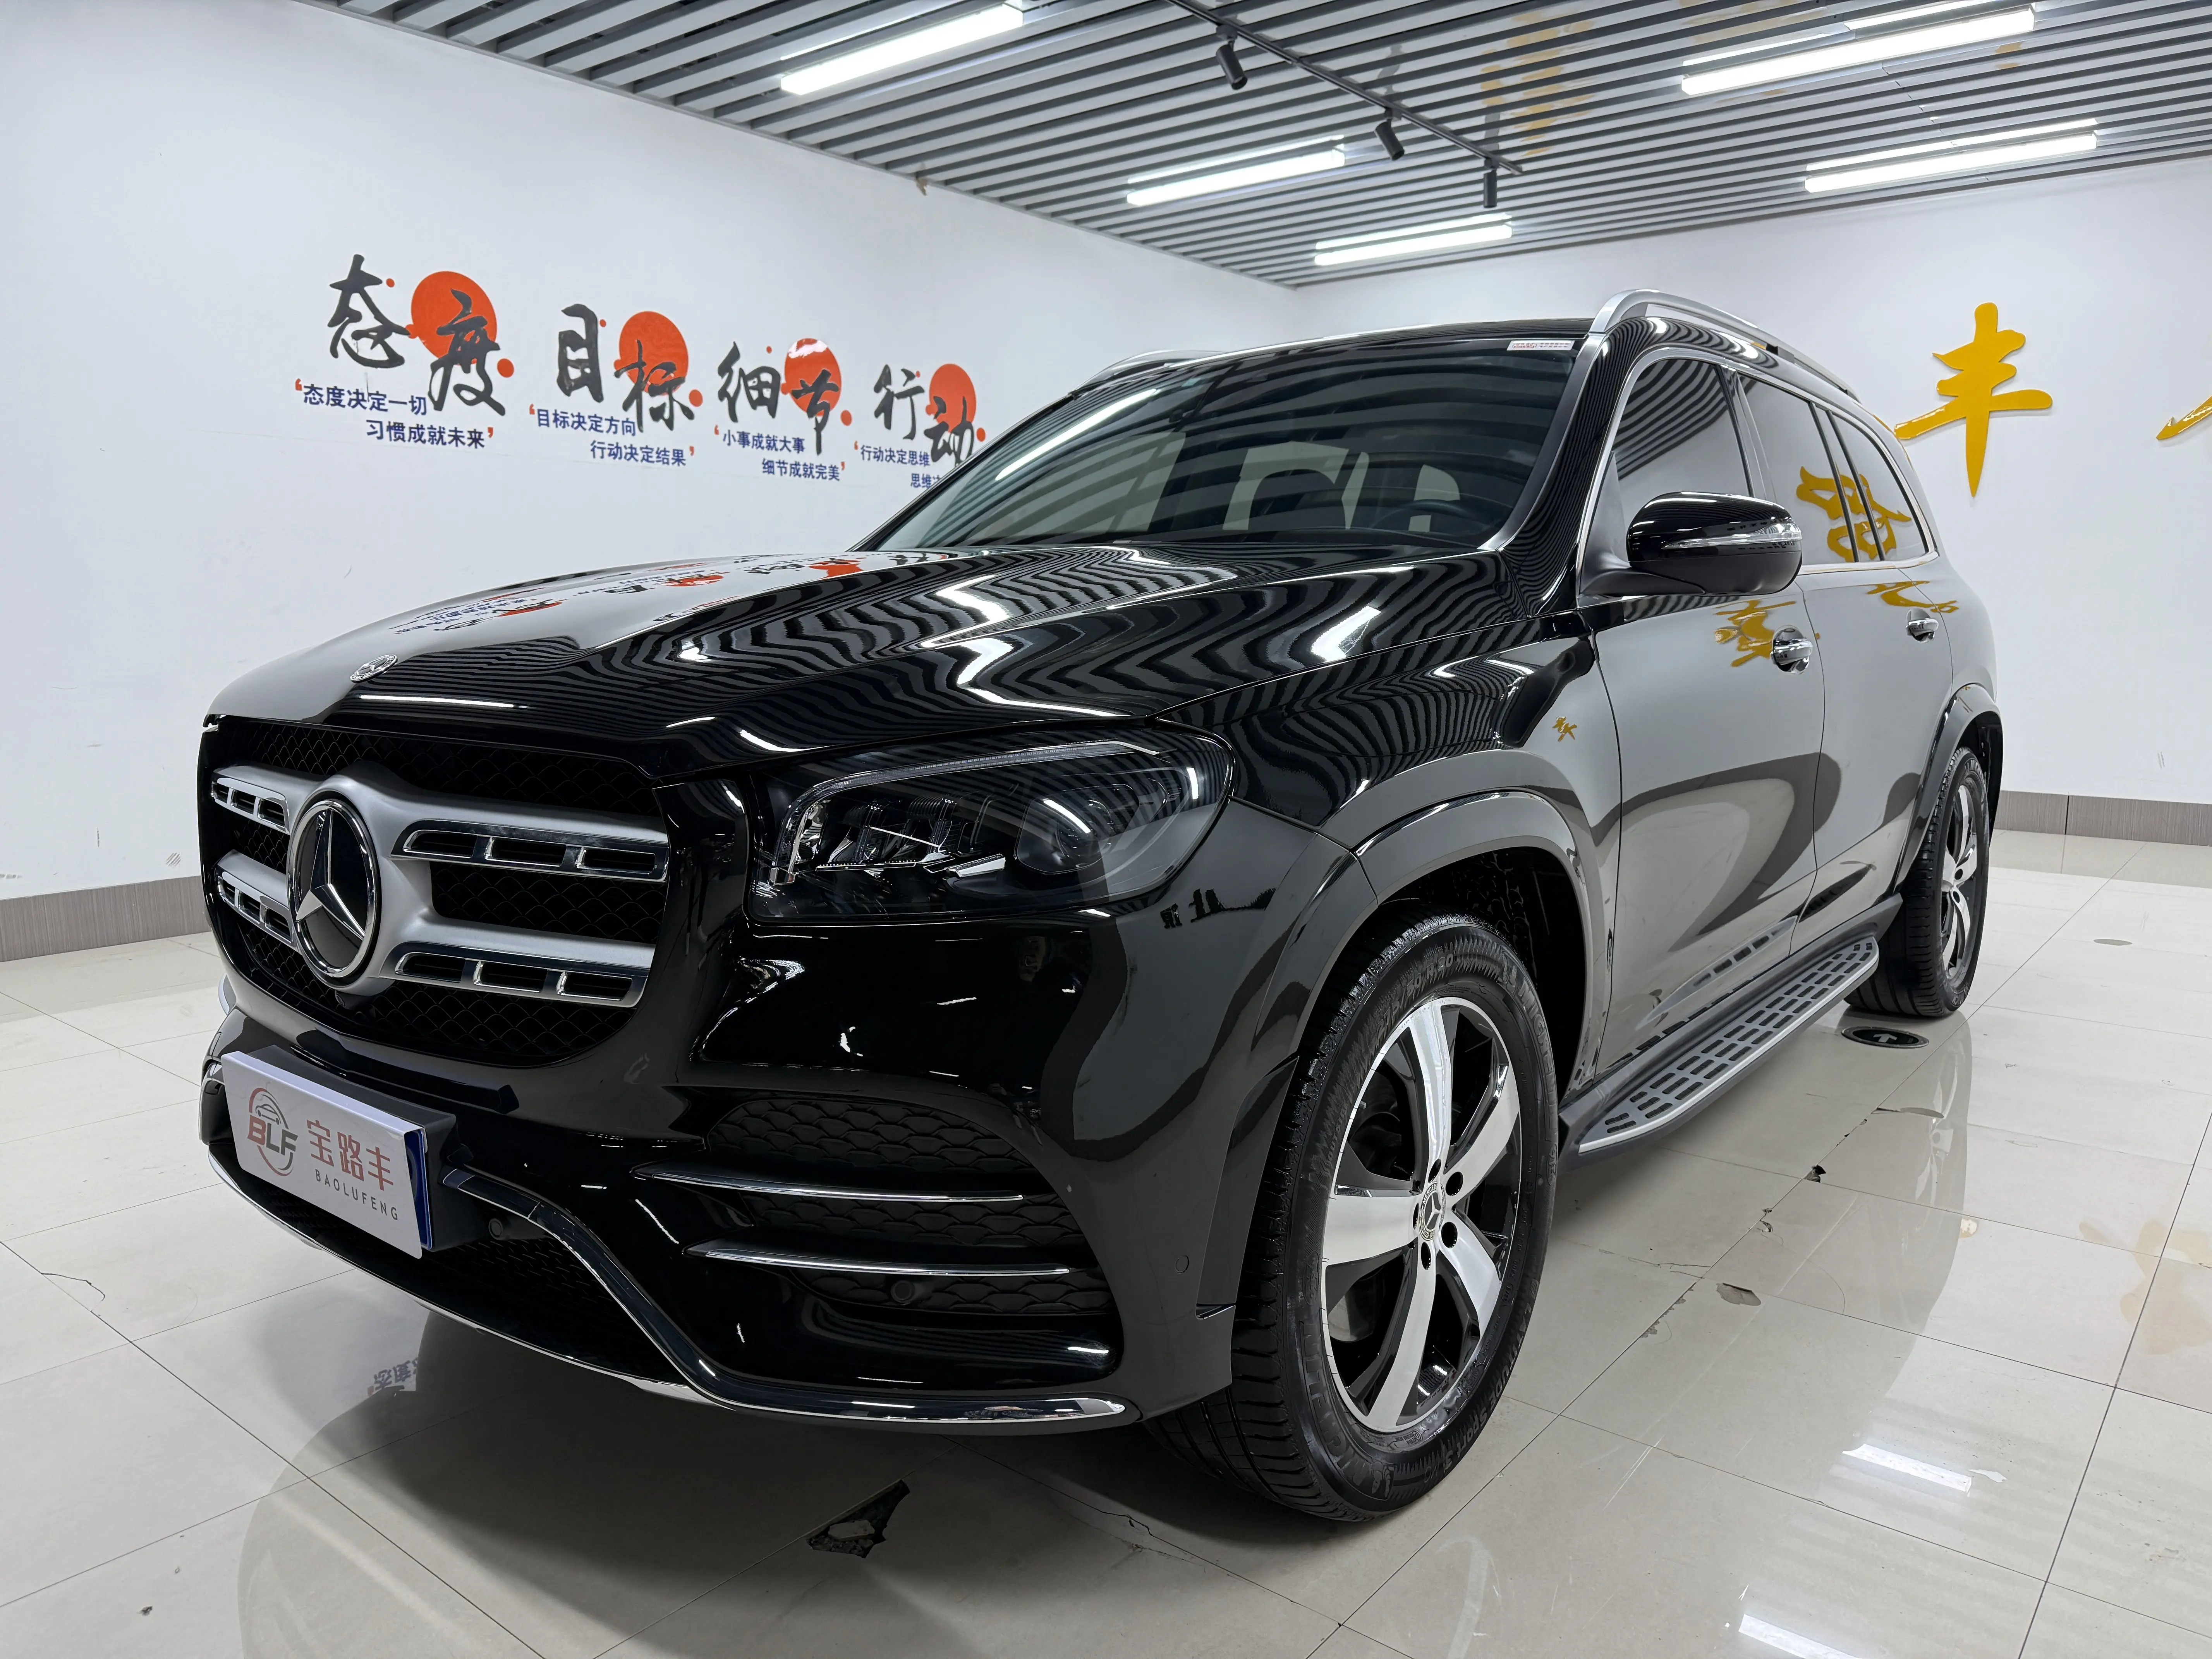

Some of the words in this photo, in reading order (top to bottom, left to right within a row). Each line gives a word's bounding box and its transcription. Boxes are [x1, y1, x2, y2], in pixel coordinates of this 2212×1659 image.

[327, 254, 505, 416] 态度
[556, 304, 694, 433] 目标
[718, 341, 838, 455] 细节
[874, 364, 974, 467] 行动
[1894, 302, 2053, 498] 丰
[247, 1115, 299, 1156] BLF
[307, 1118, 394, 1191] 宝路丰
[315, 1168, 398, 1221] BAOLUFENG
